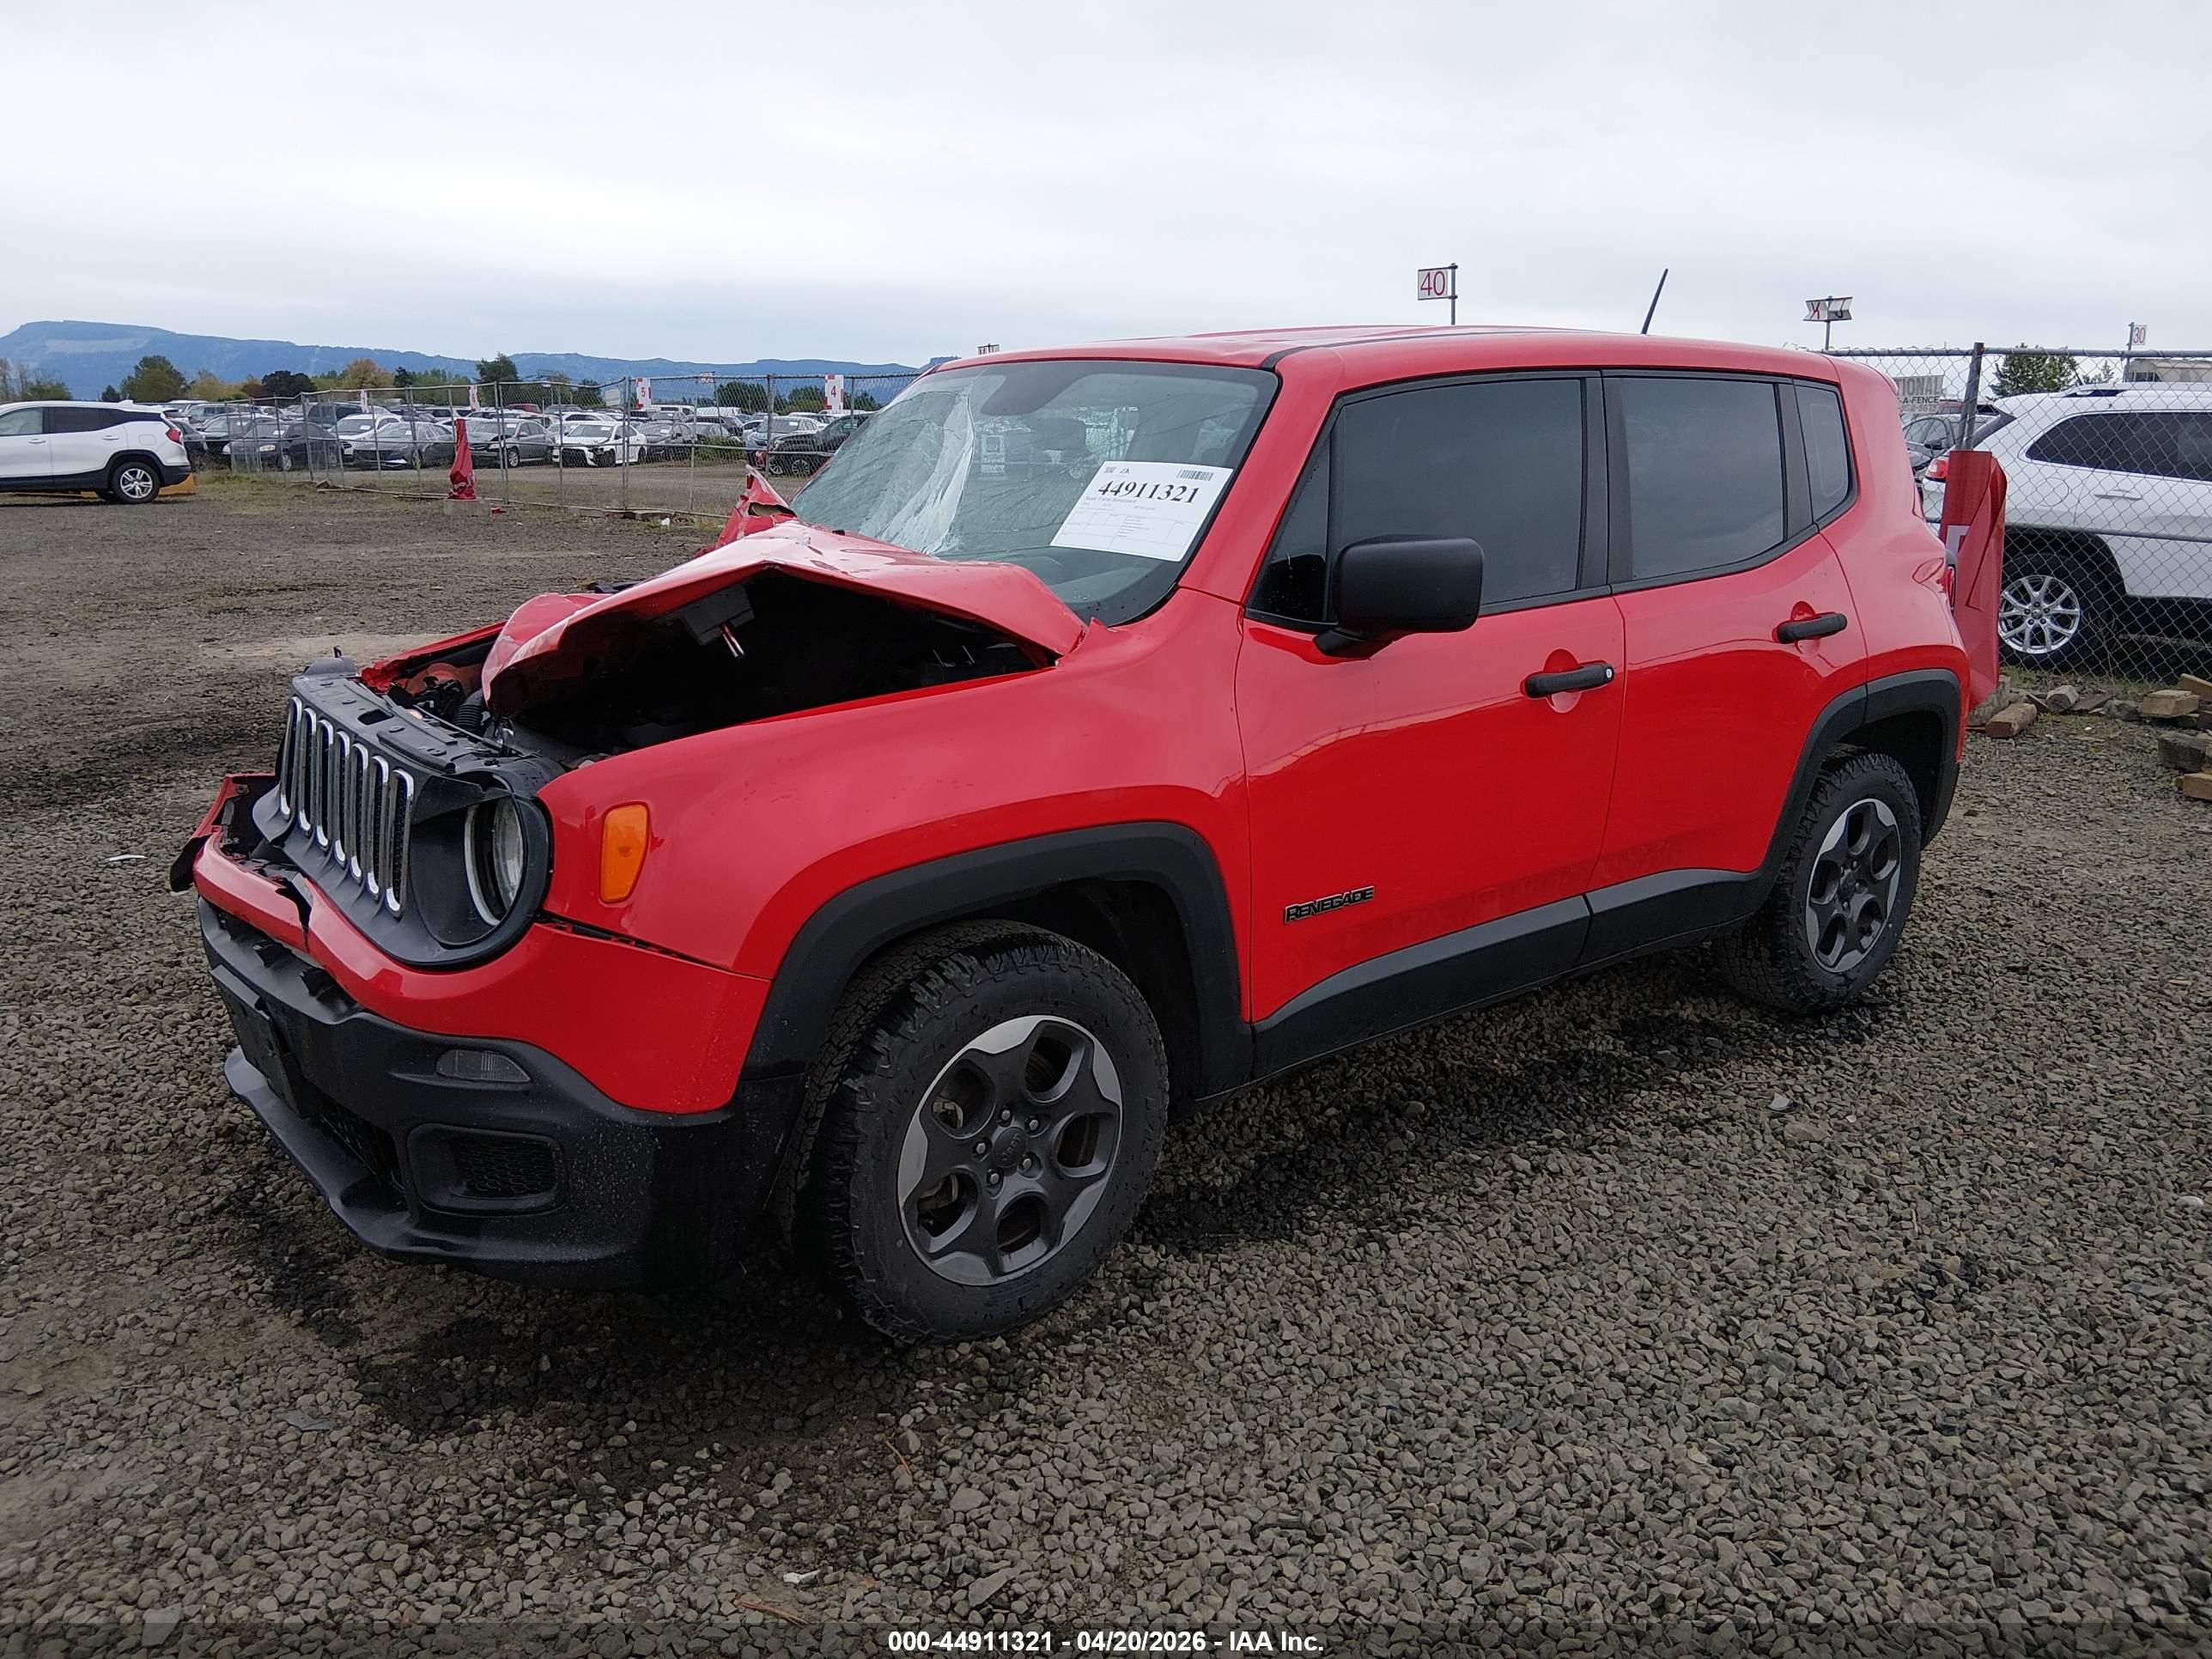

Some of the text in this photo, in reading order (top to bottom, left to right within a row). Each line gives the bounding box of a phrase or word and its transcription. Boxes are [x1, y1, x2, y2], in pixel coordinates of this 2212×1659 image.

[1419, 270, 1446, 296] 40
[2132, 326, 2146, 343] 30
[641, 386, 646, 398] 5
[830, 386, 837, 398] 4
[1097, 480, 1200, 503] 44911321
[1284, 884, 1375, 925] RENEGADE
